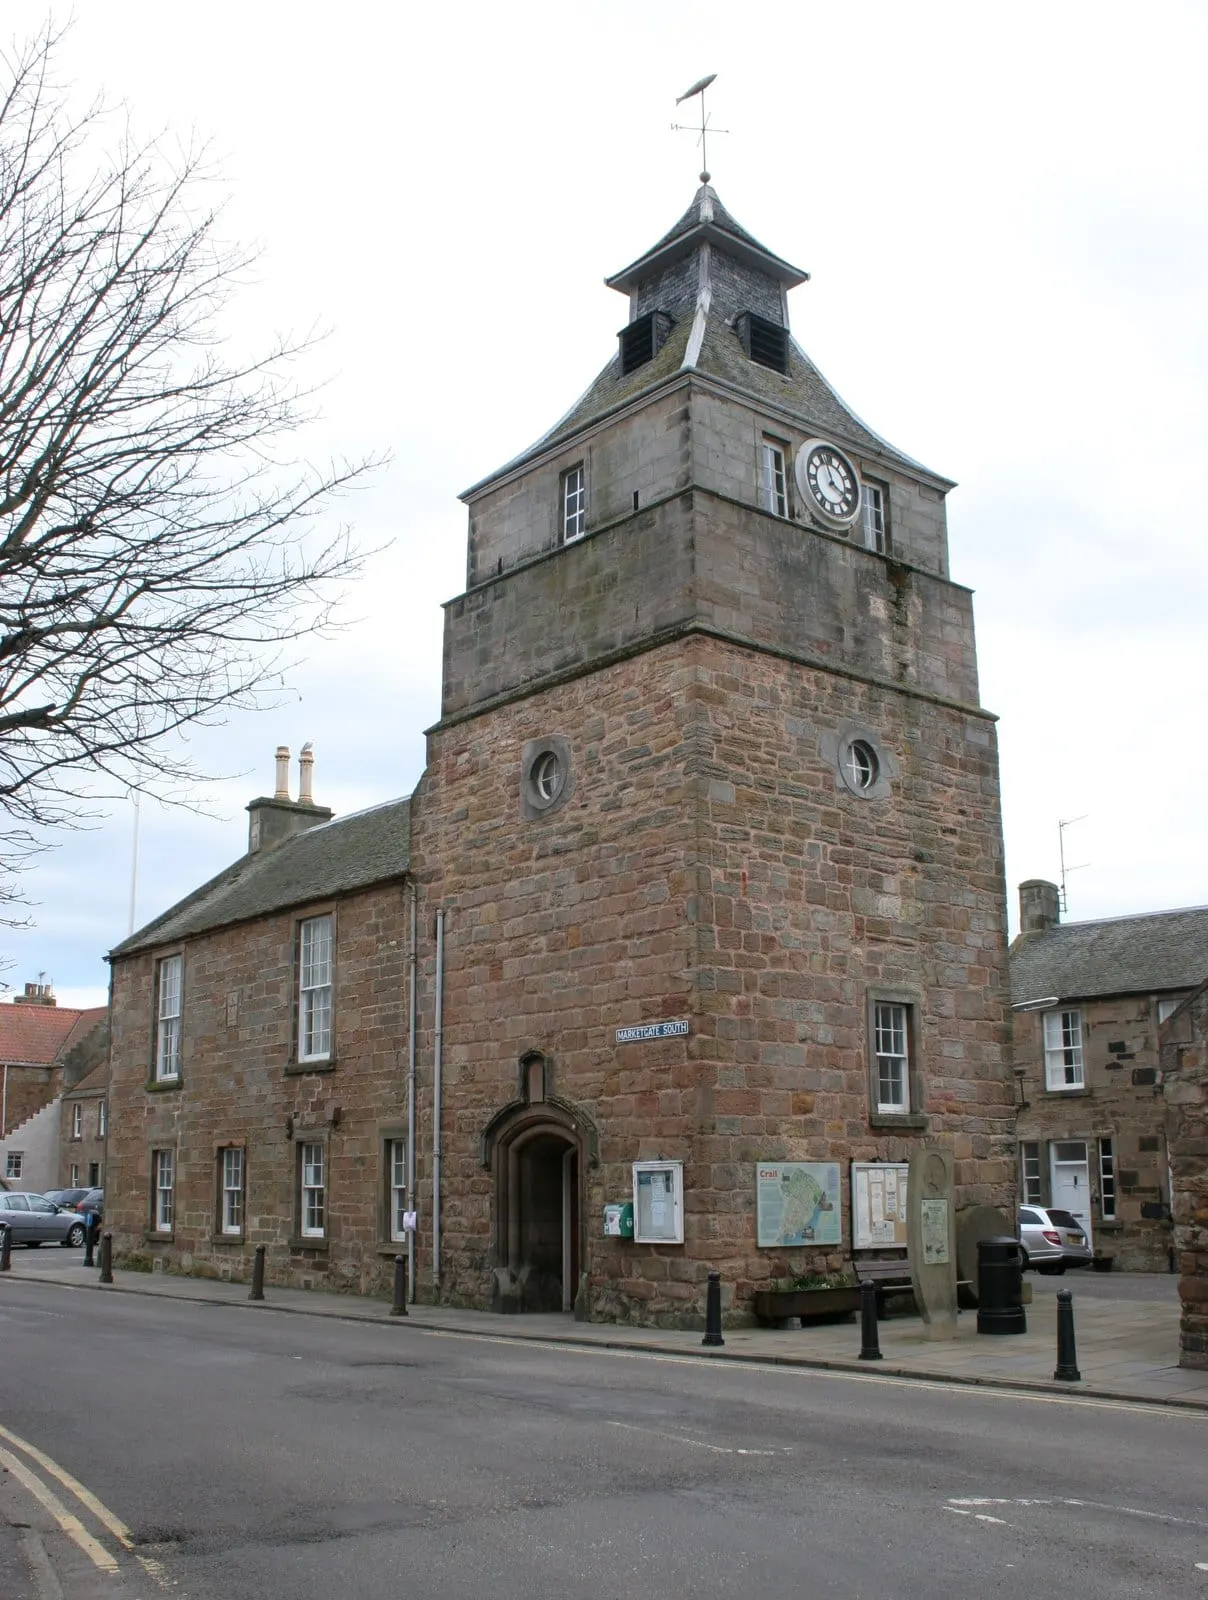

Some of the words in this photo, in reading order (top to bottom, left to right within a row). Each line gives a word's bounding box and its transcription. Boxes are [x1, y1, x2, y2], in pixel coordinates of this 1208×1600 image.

[617, 1026, 660, 1040] MARKETGATE
[663, 1023, 687, 1034] SOUTH
[760, 1170, 777, 1178] Crail
